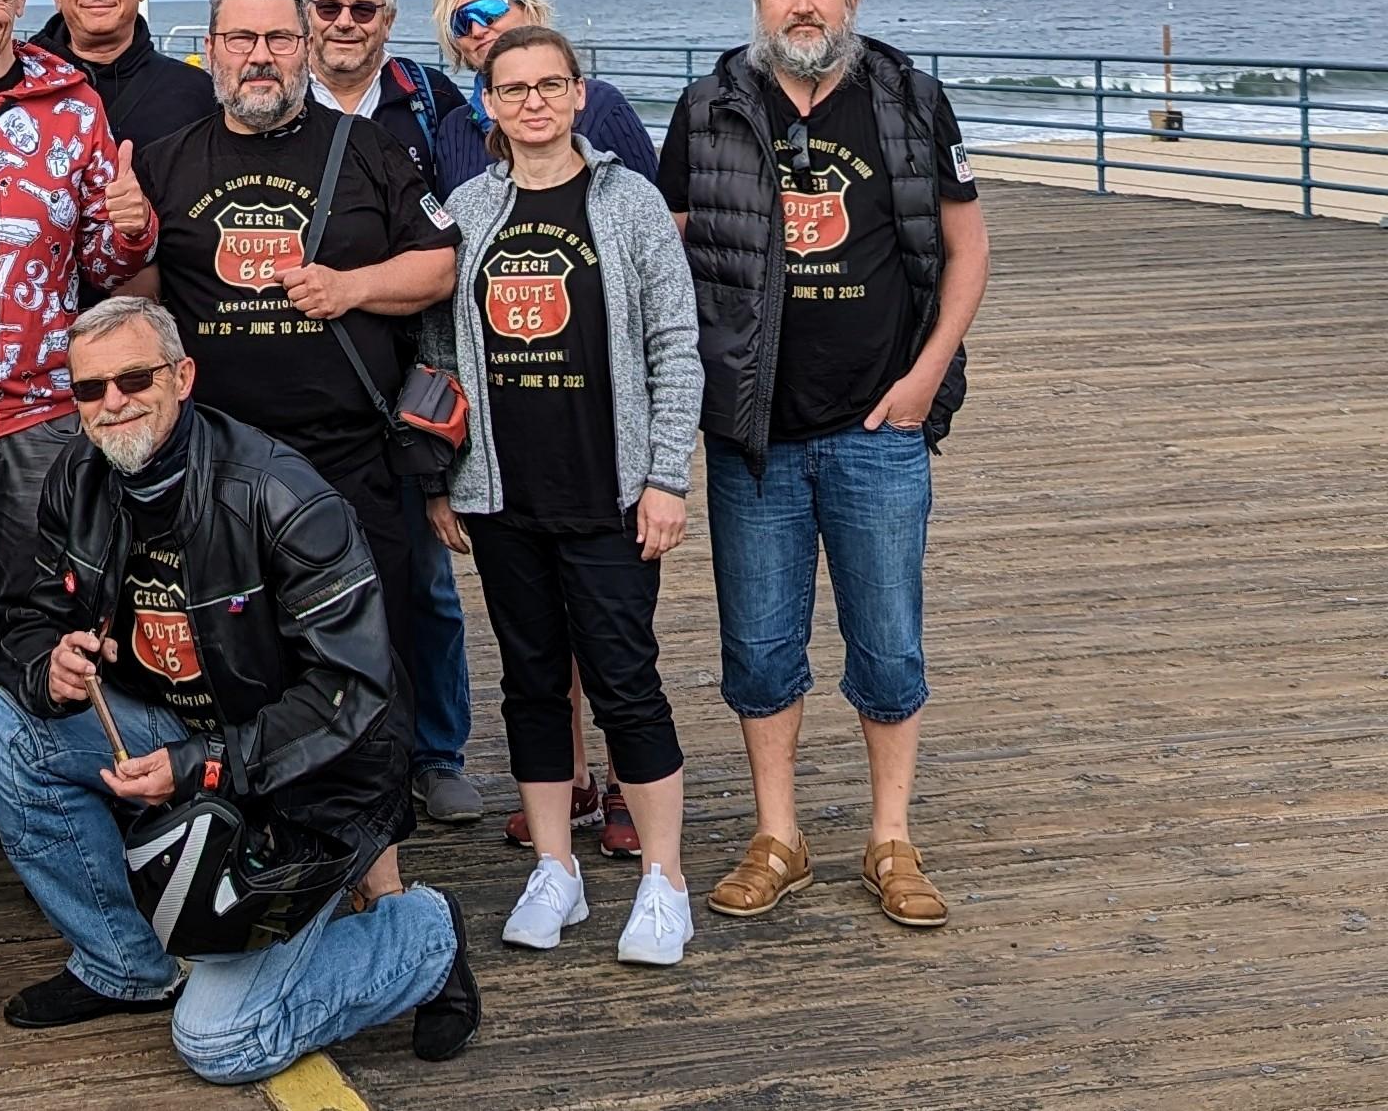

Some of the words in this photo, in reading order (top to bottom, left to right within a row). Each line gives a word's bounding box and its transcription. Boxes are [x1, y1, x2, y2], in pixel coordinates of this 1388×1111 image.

[54, 159, 68, 176] 13
[808, 138, 838, 154] ROUTE
[837, 146, 852, 161] 66
[850, 156, 875, 180] TOUR
[188, 191, 215, 219] CZECH
[214, 188, 223, 199] &
[225, 174, 262, 191] SLOVAK
[265, 175, 297, 192] ROUTE
[297, 186, 311, 200] 66
[783, 199, 834, 219] OUTE
[233, 212, 284, 228] CZECH
[784, 220, 820, 244] 66
[224, 235, 291, 257] ROUTE
[499, 222, 535, 241] SLOVAK
[536, 222, 567, 239] ROUTE
[565, 233, 580, 247] 66
[577, 242, 599, 267] TOUR
[239, 258, 275, 281] 66
[500, 260, 550, 274] CZECH
[784, 263, 841, 275] OCIATION
[492, 283, 556, 304] ROUTE
[791, 285, 818, 299] JUNE
[822, 286, 835, 300] 10
[838, 285, 865, 299] 2023
[198, 321, 217, 335] MAY
[219, 322, 232, 334] 26
[249, 321, 276, 335] JUNE
[279, 321, 292, 334] 10
[297, 320, 324, 333] 2023
[507, 306, 544, 331] 66
[490, 351, 565, 365] ASSOCIATION
[519, 374, 544, 388] JUNE
[548, 374, 560, 388] 10
[563, 375, 585, 388] 2023
[142, 621, 191, 646] OUTE
[165, 692, 212, 707] OCIATION
